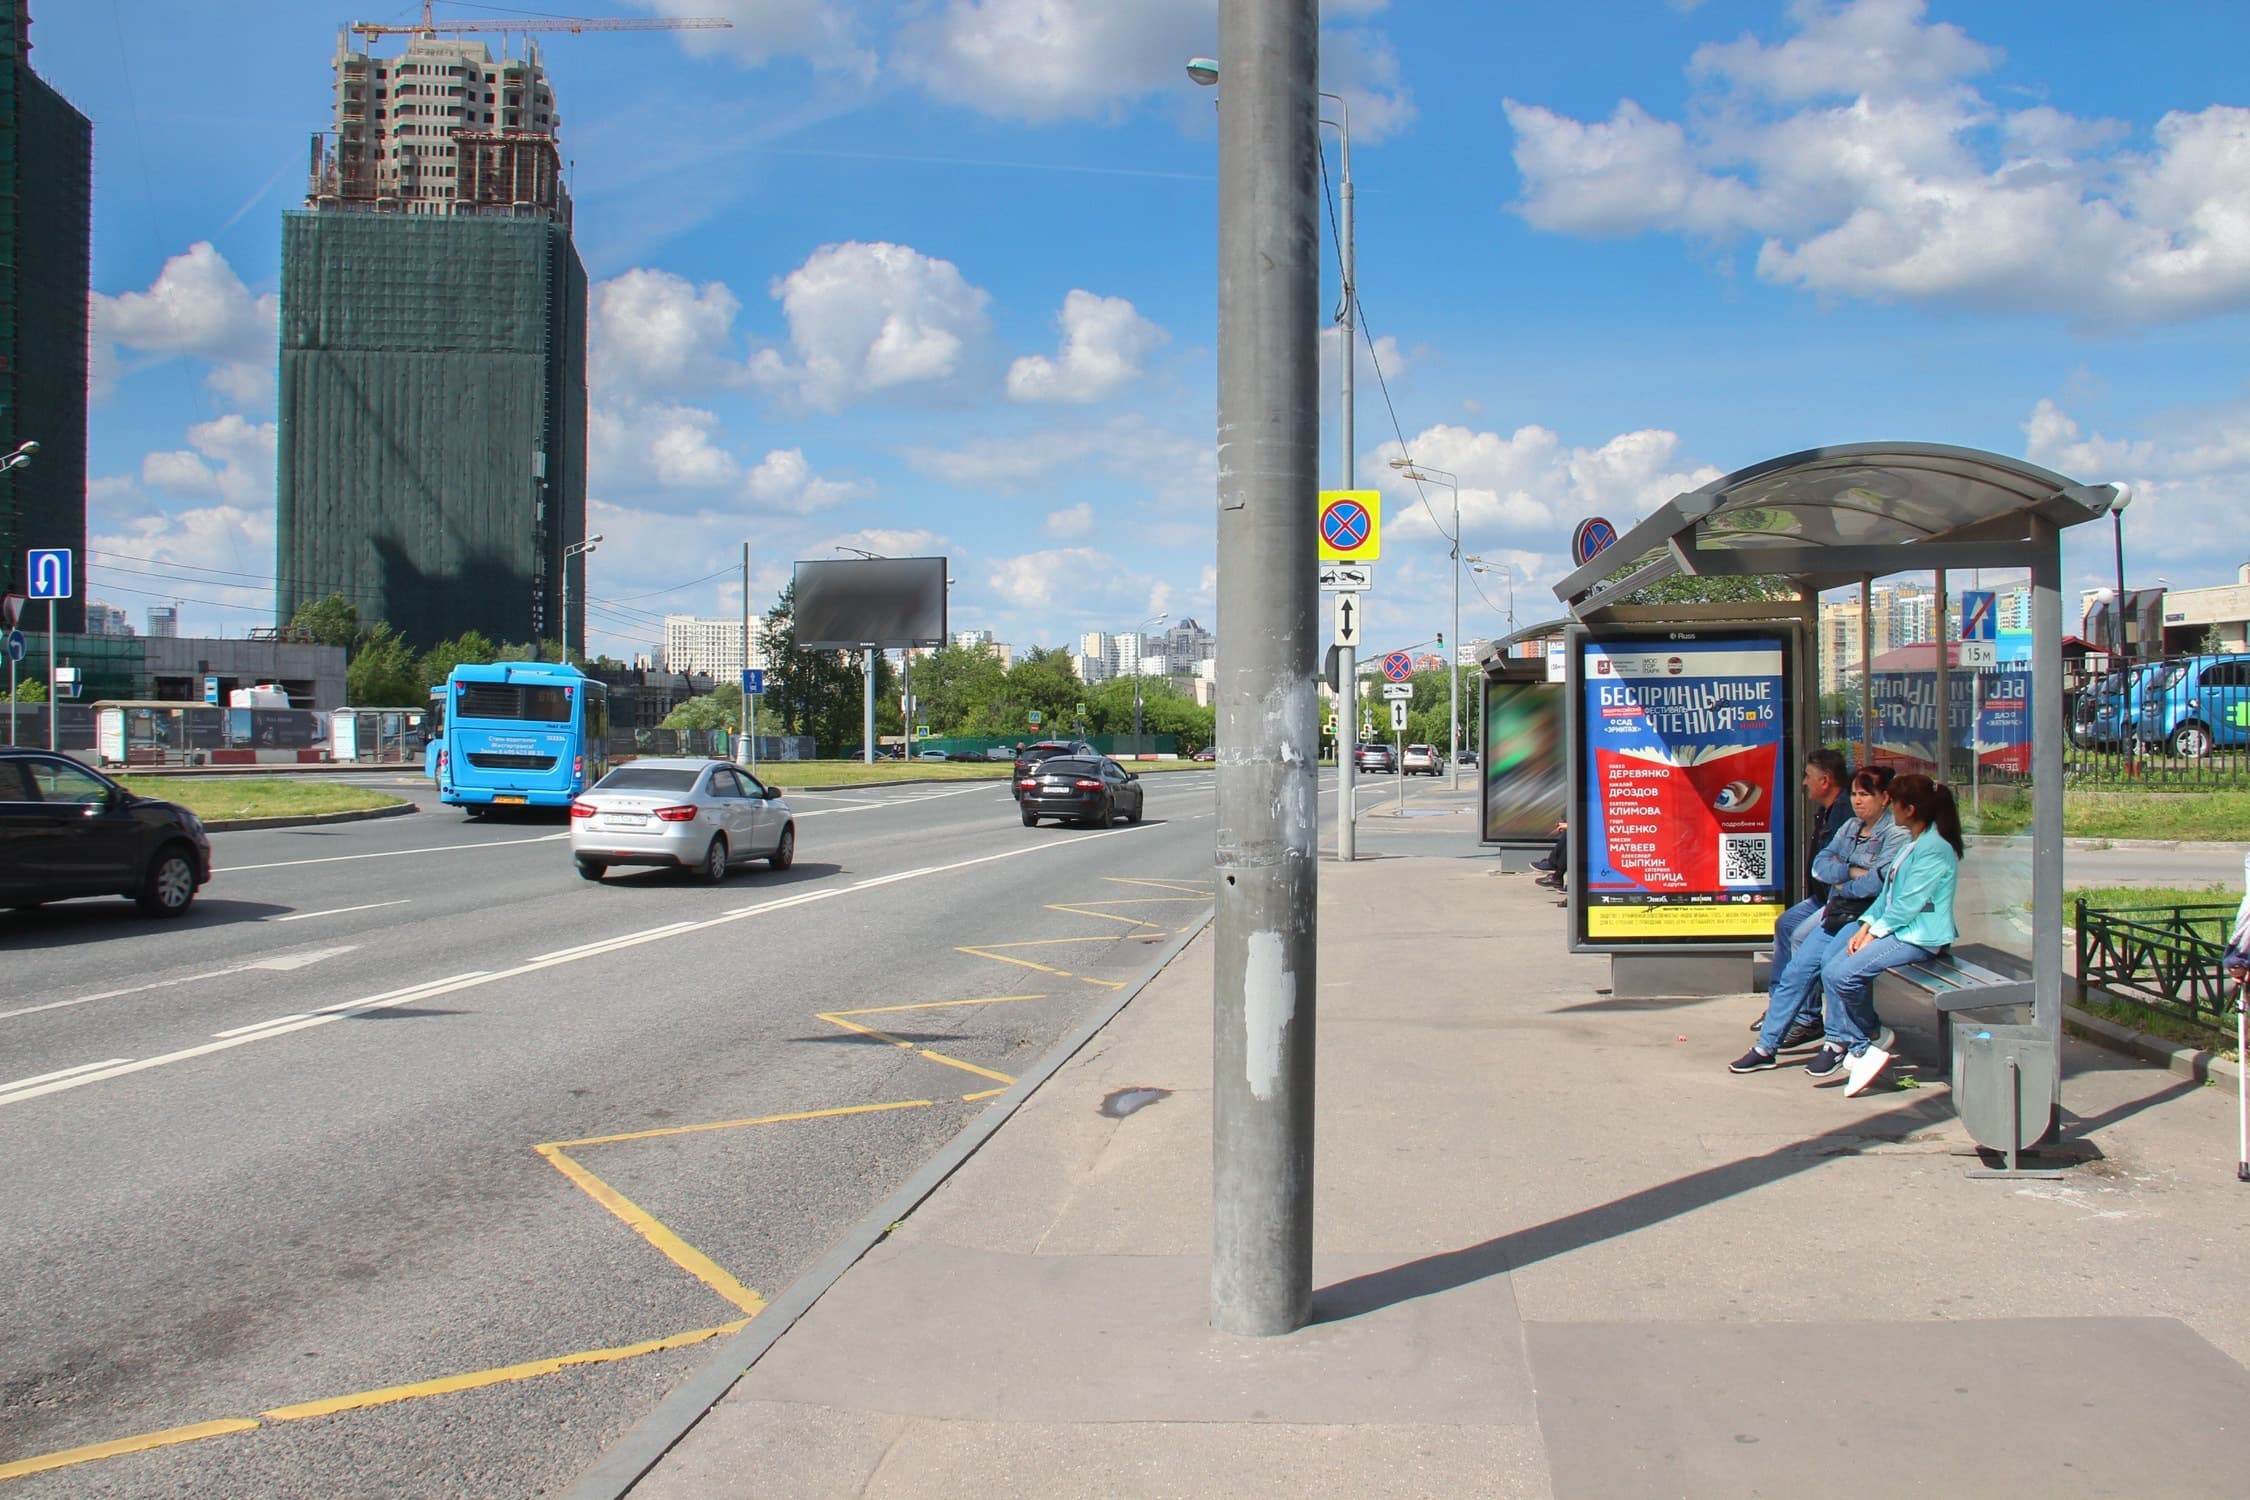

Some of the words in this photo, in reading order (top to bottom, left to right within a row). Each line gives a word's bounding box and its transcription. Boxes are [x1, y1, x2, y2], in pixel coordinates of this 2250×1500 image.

[1677, 632, 1696, 640] Russ
[1967, 647, 1980, 661] 15
[1600, 681, 1772, 712] БЕСПРИНЦЫПНЫЕ
[1644, 706, 1689, 714] ФЕСТИВАЛЬ
[1731, 706, 1745, 721] 15
[1757, 704, 1774, 720] 16
[1646, 707, 1732, 734] ЧТЕНИЯ
[1608, 769, 1670, 779] ДЕРЕВЯНКО
[1608, 788, 1659, 798] ДРОЗДОВ
[1609, 807, 1661, 816] КЛИМОВА
[1609, 825, 1658, 835] КУЦЕНКО
[1609, 843, 1656, 852] МАТВЕЕВ
[1621, 859, 1666, 868] ЦЫПКИН
[1644, 873, 1684, 882] ШПИЦА
